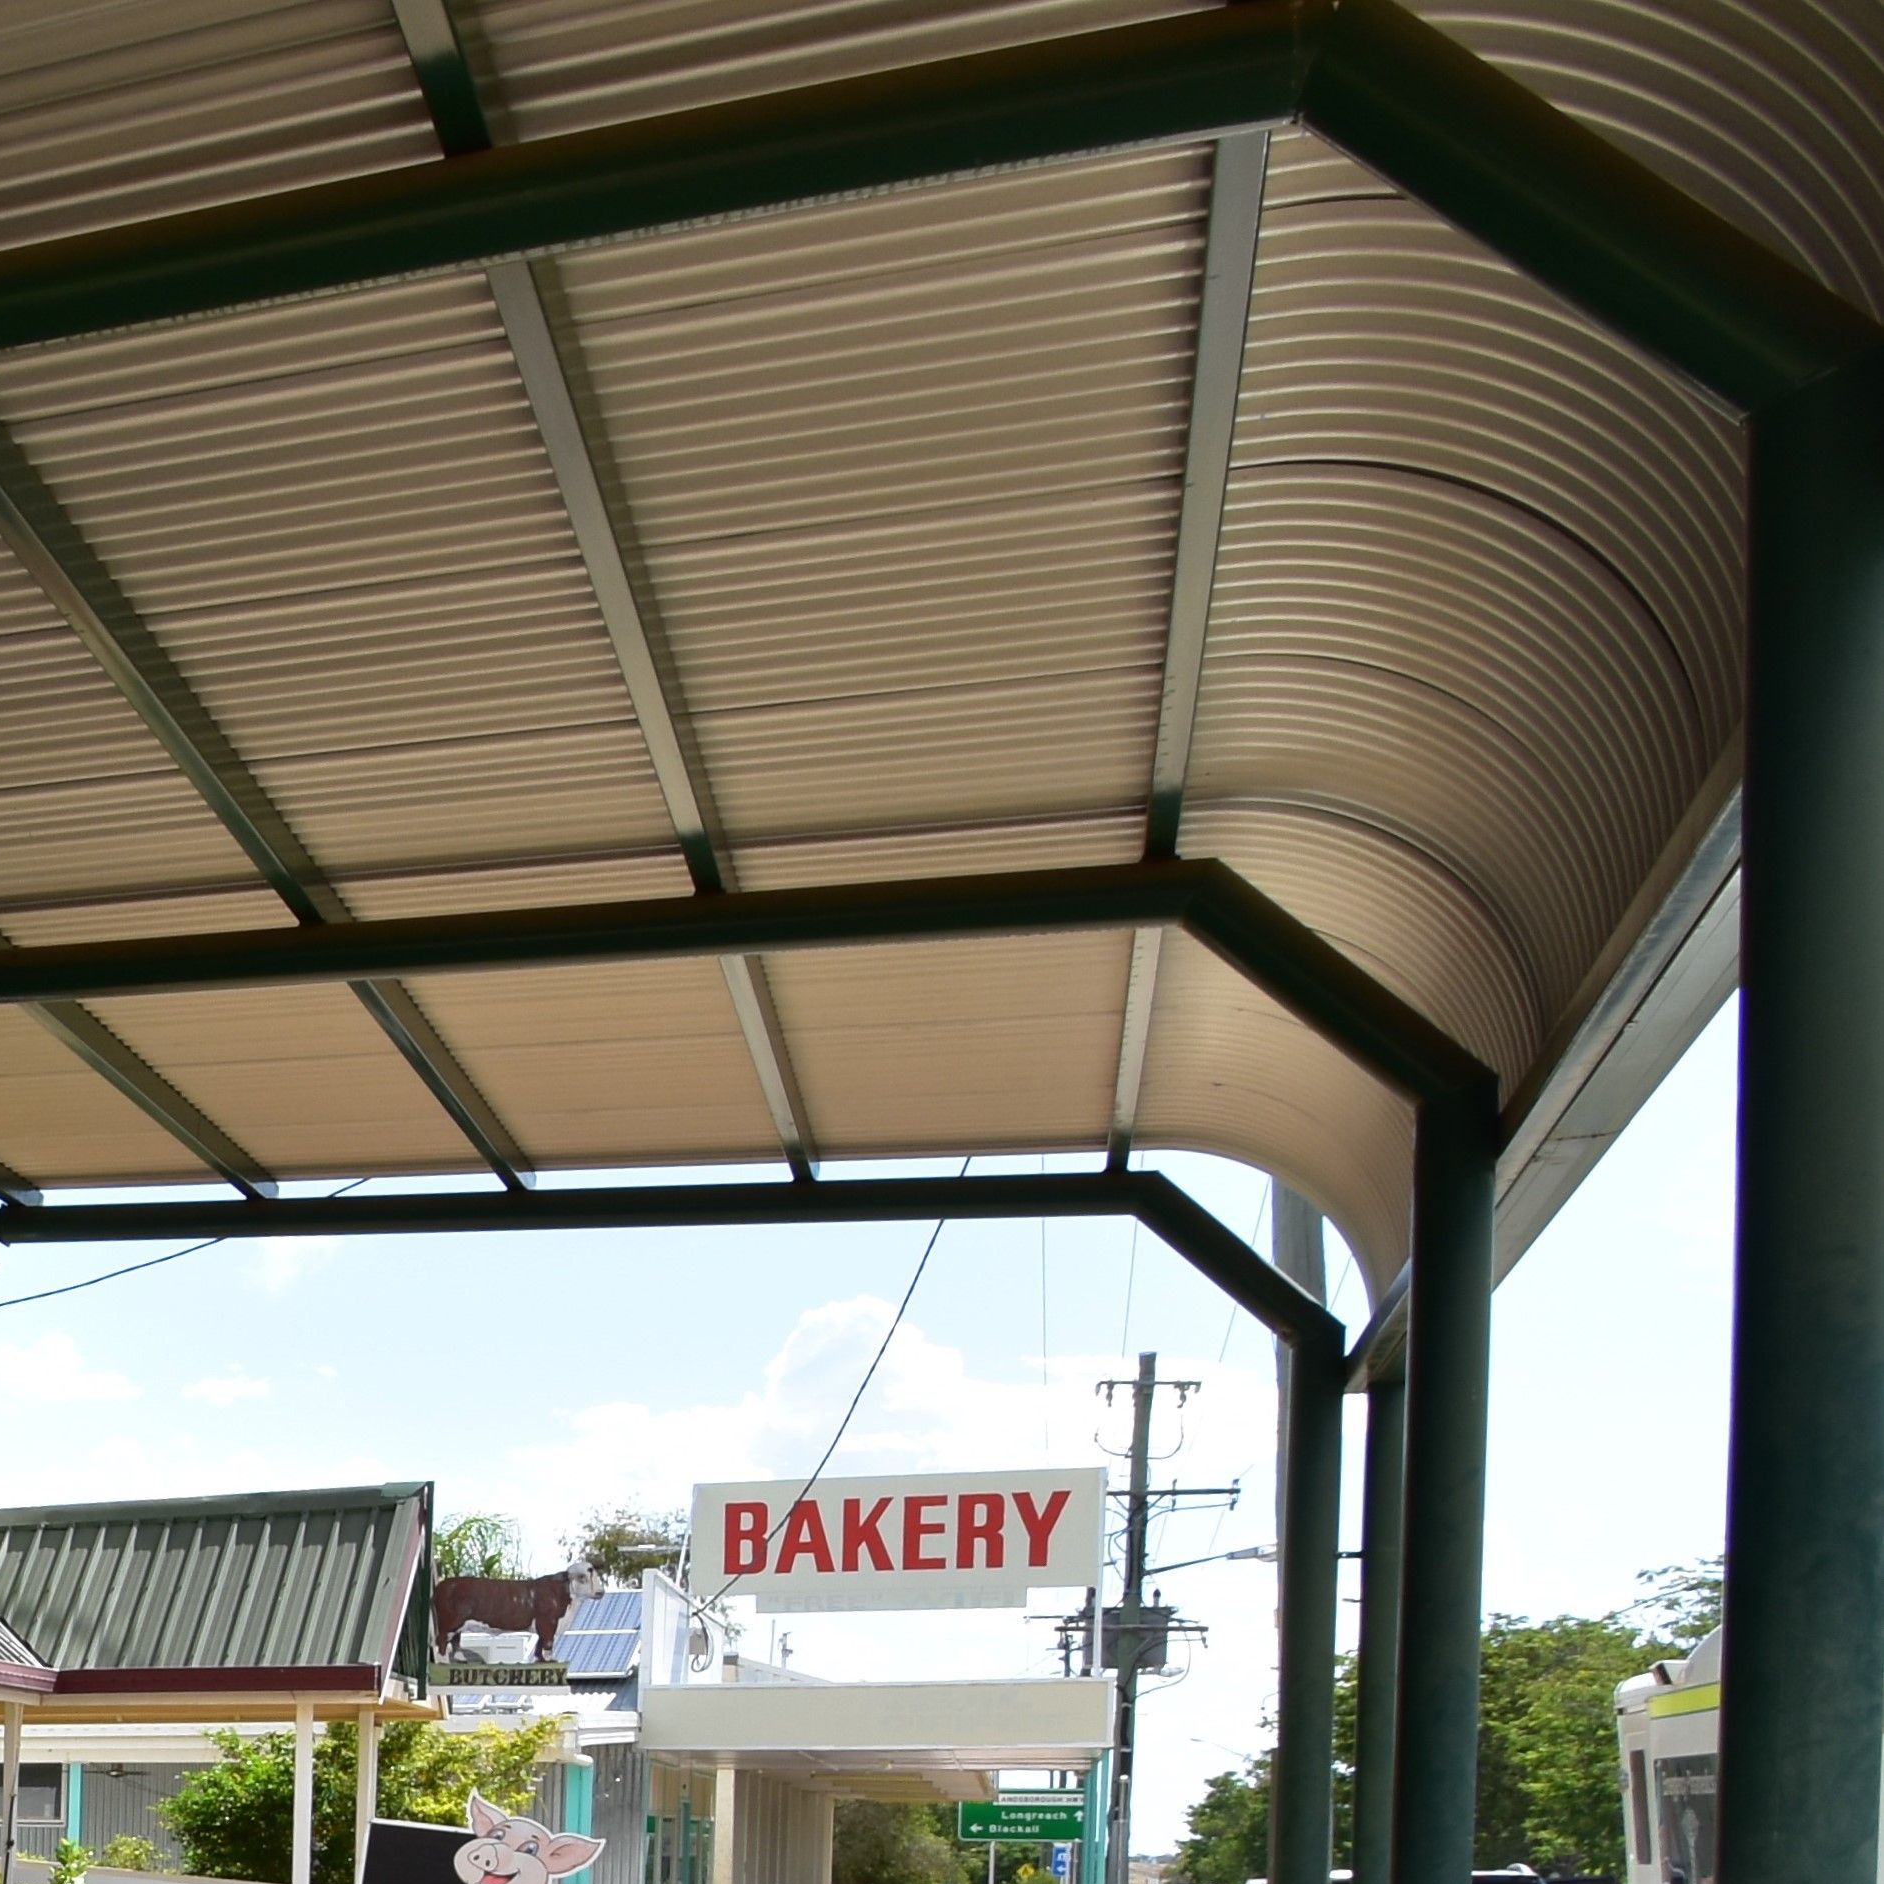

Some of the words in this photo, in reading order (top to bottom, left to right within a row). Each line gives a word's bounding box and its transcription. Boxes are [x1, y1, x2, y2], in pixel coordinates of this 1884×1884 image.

[722, 1489, 1073, 1576] BAKERY
[449, 1667, 568, 1686] BUTCHERY
[1000, 1795, 1063, 1803] ANDSBOROUGH
[1001, 1811, 1068, 1821] Longreach
[988, 1824, 1040, 1834] Blackall
